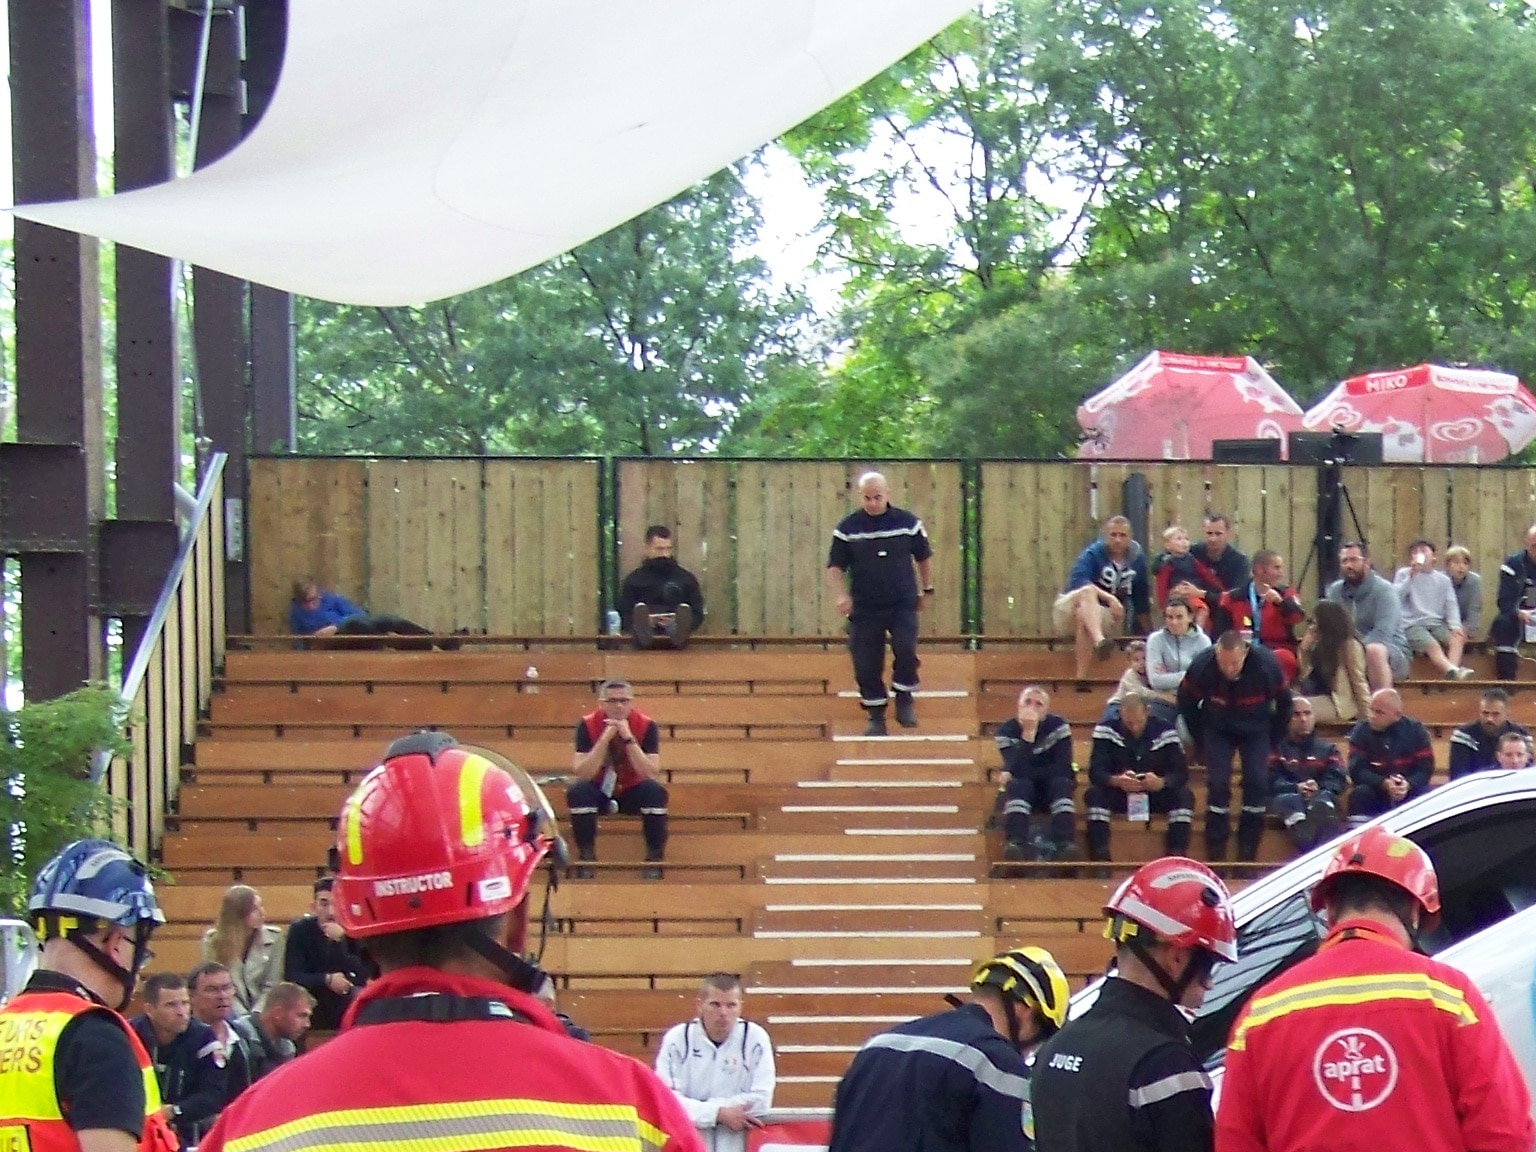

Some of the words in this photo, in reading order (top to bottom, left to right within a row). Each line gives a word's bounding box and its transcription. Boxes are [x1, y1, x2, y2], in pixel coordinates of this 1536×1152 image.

[1366, 374, 1409, 392] MIKO
[374, 872, 454, 897] INSTRUCTOR
[1048, 1053, 1083, 1072] JUGE
[1323, 1054, 1387, 1082] aprat
